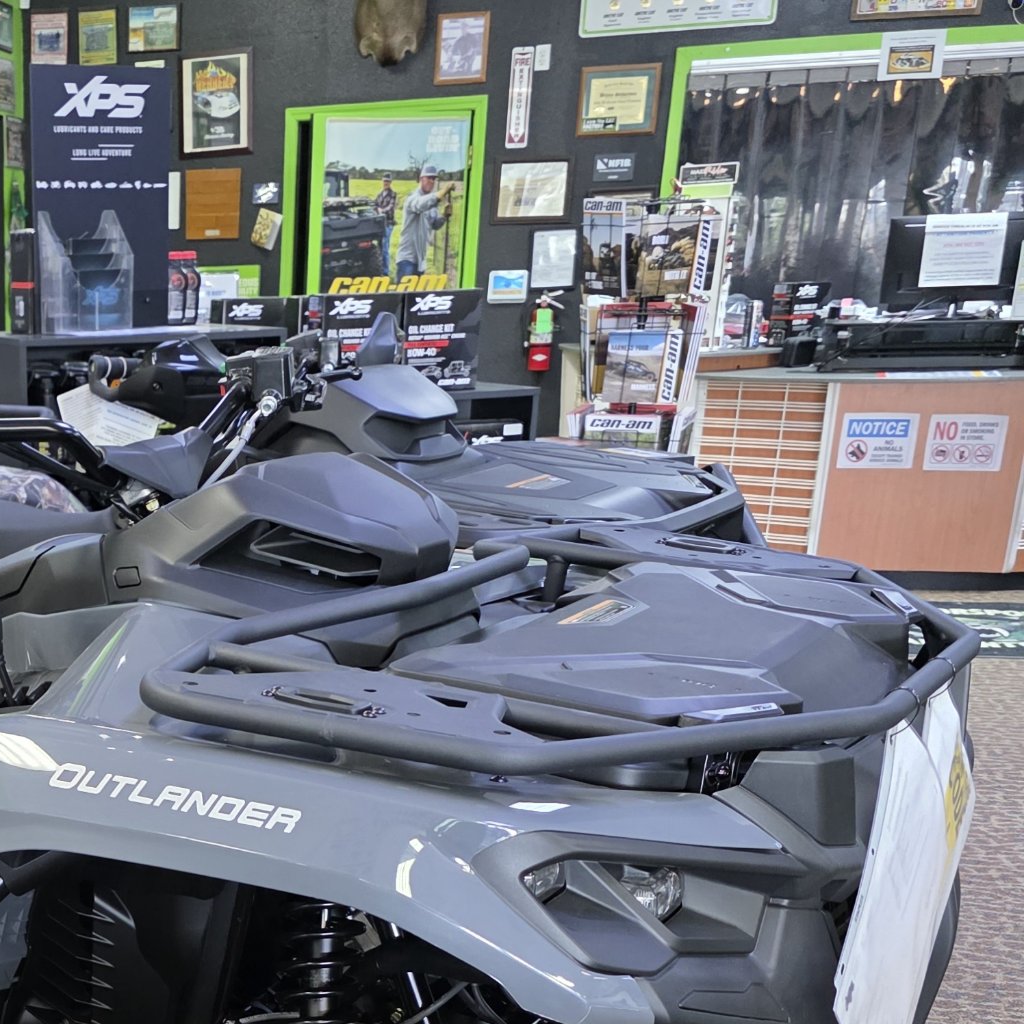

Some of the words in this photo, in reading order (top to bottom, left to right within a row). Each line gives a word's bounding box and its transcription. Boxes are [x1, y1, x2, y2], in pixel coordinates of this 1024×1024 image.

[515, 58, 531, 66] FIRE
[54, 75, 151, 118] XPS
[53, 125, 87, 133] LUBRICANTS
[115, 126, 143, 134] PRODUCTS
[584, 200, 622, 212] can-am
[693, 219, 711, 290] can-am
[328, 274, 448, 294] can-am
[228, 302, 264, 318] XPS
[329, 297, 374, 316] XPS
[410, 294, 455, 312] XPS
[662, 334, 680, 401] can-am
[590, 418, 653, 430] can-am
[849, 421, 908, 435] NOTICE
[933, 422, 958, 441] NO
[48, 762, 302, 834] OUTLANDER
